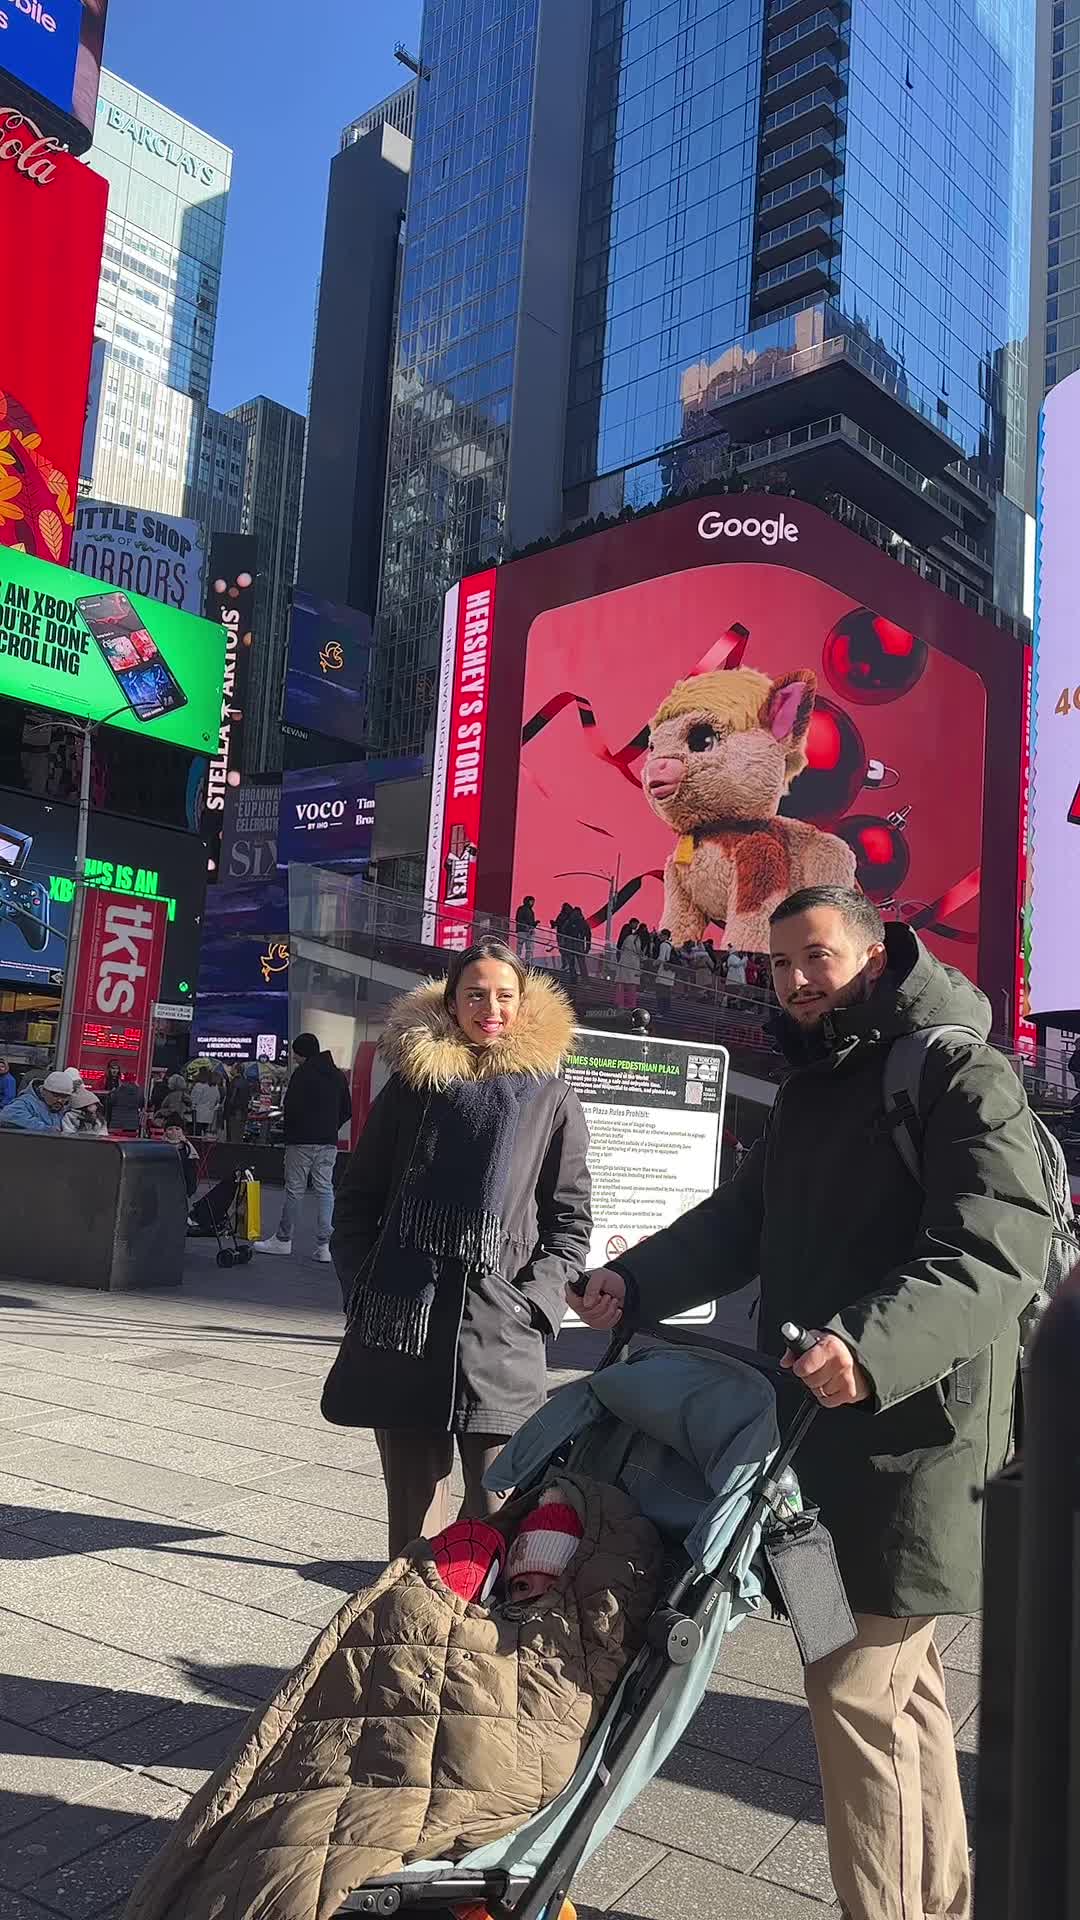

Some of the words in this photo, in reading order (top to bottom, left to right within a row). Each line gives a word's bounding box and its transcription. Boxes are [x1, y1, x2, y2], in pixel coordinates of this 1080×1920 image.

[8, 0, 57, 33] bile
[107, 106, 217, 187] BARCLAYS
[74, 507, 138, 534] ITTLE
[142, 516, 192, 559] SHOP
[118, 536, 132, 547] OF
[698, 511, 800, 546] Google
[4, 582, 30, 611] AN
[32, 590, 79, 627] XBOX
[45, 619, 91, 655] DONE
[457, 589, 491, 717] HERSHEY'S
[441, 627, 453, 713] GARDENS
[281, 725, 309, 740] KEVANI
[205, 724, 231, 811] STELLA
[451, 720, 482, 799] STORE
[239, 787, 281, 801] BROADWA
[115, 864, 134, 890] IS
[134, 869, 159, 895] AN
[96, 904, 154, 1014] tkts
[567, 1055, 588, 1065] TIMES
[589, 1056, 617, 1068] SQUARE
[617, 1059, 658, 1073] PEDESTRIAN
[658, 1063, 680, 1076] PLAZA
[592, 1106, 608, 1115] Plaza
[609, 1108, 625, 1117] Rules
